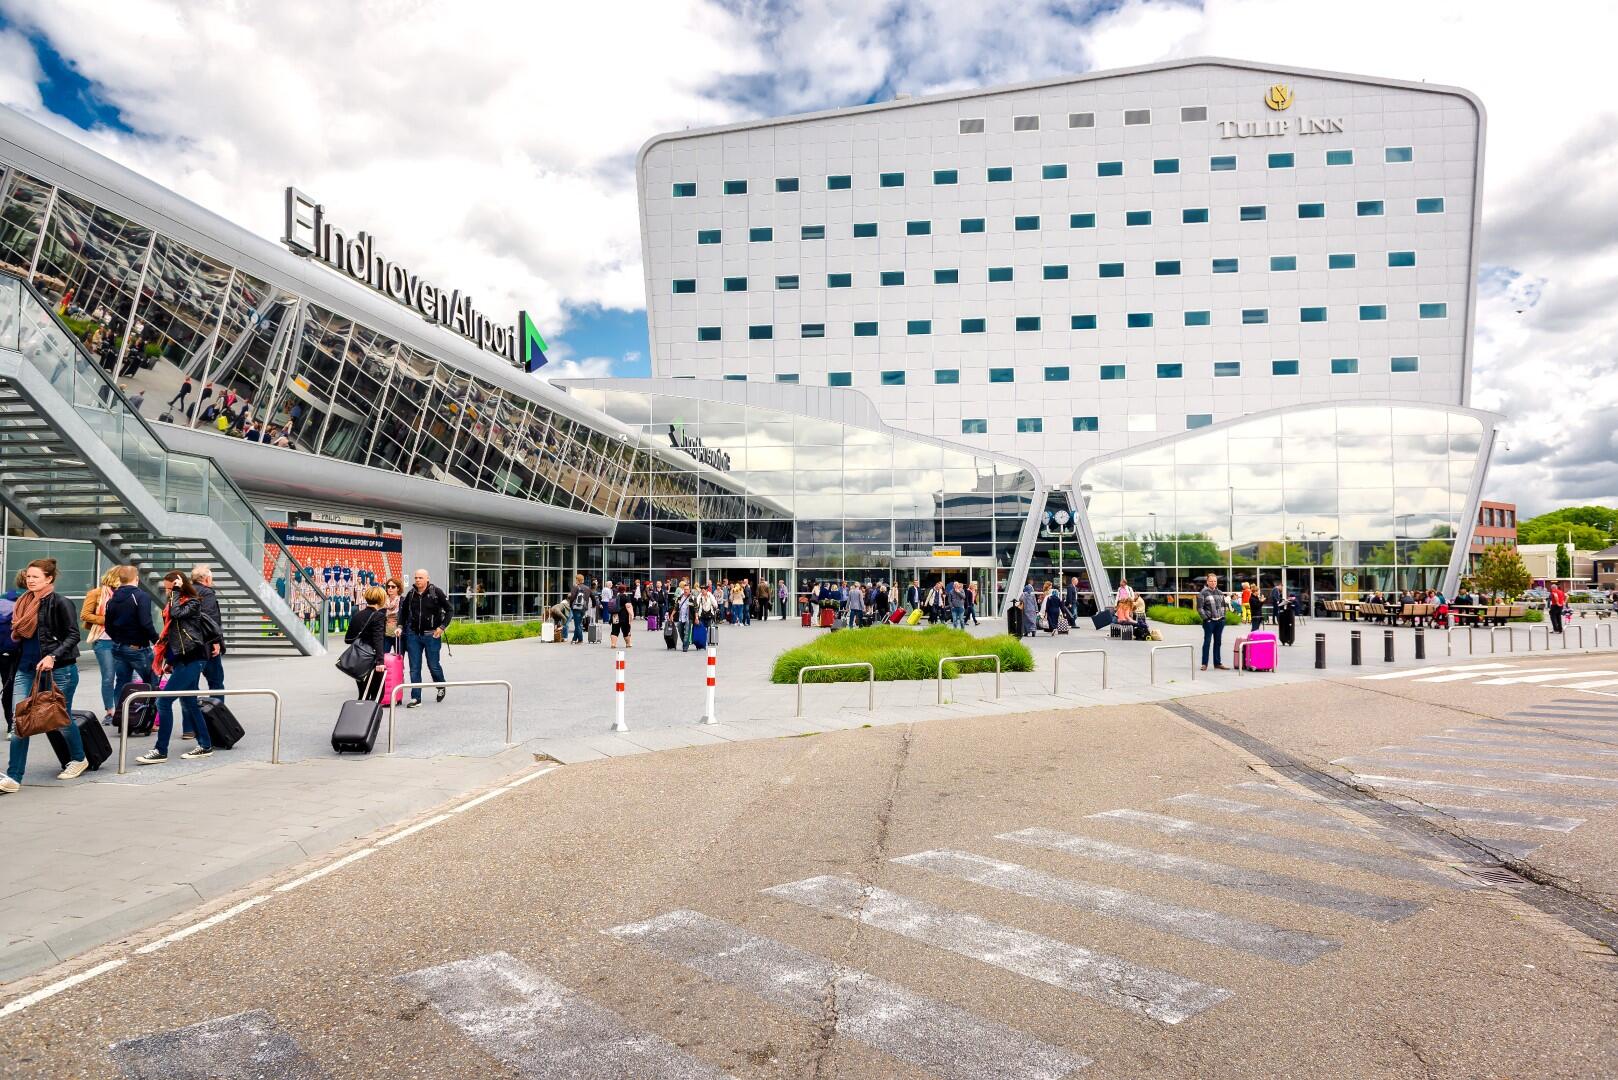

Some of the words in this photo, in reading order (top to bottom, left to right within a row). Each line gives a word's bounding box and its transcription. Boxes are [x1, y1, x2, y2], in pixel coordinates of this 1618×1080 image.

[1217, 120, 1289, 139] TULIP
[1298, 115, 1344, 136] INN
[321, 512, 341, 522] PHILIPS
[329, 537, 350, 545] OFFICIAL
[350, 538, 369, 546] AIRPORT
